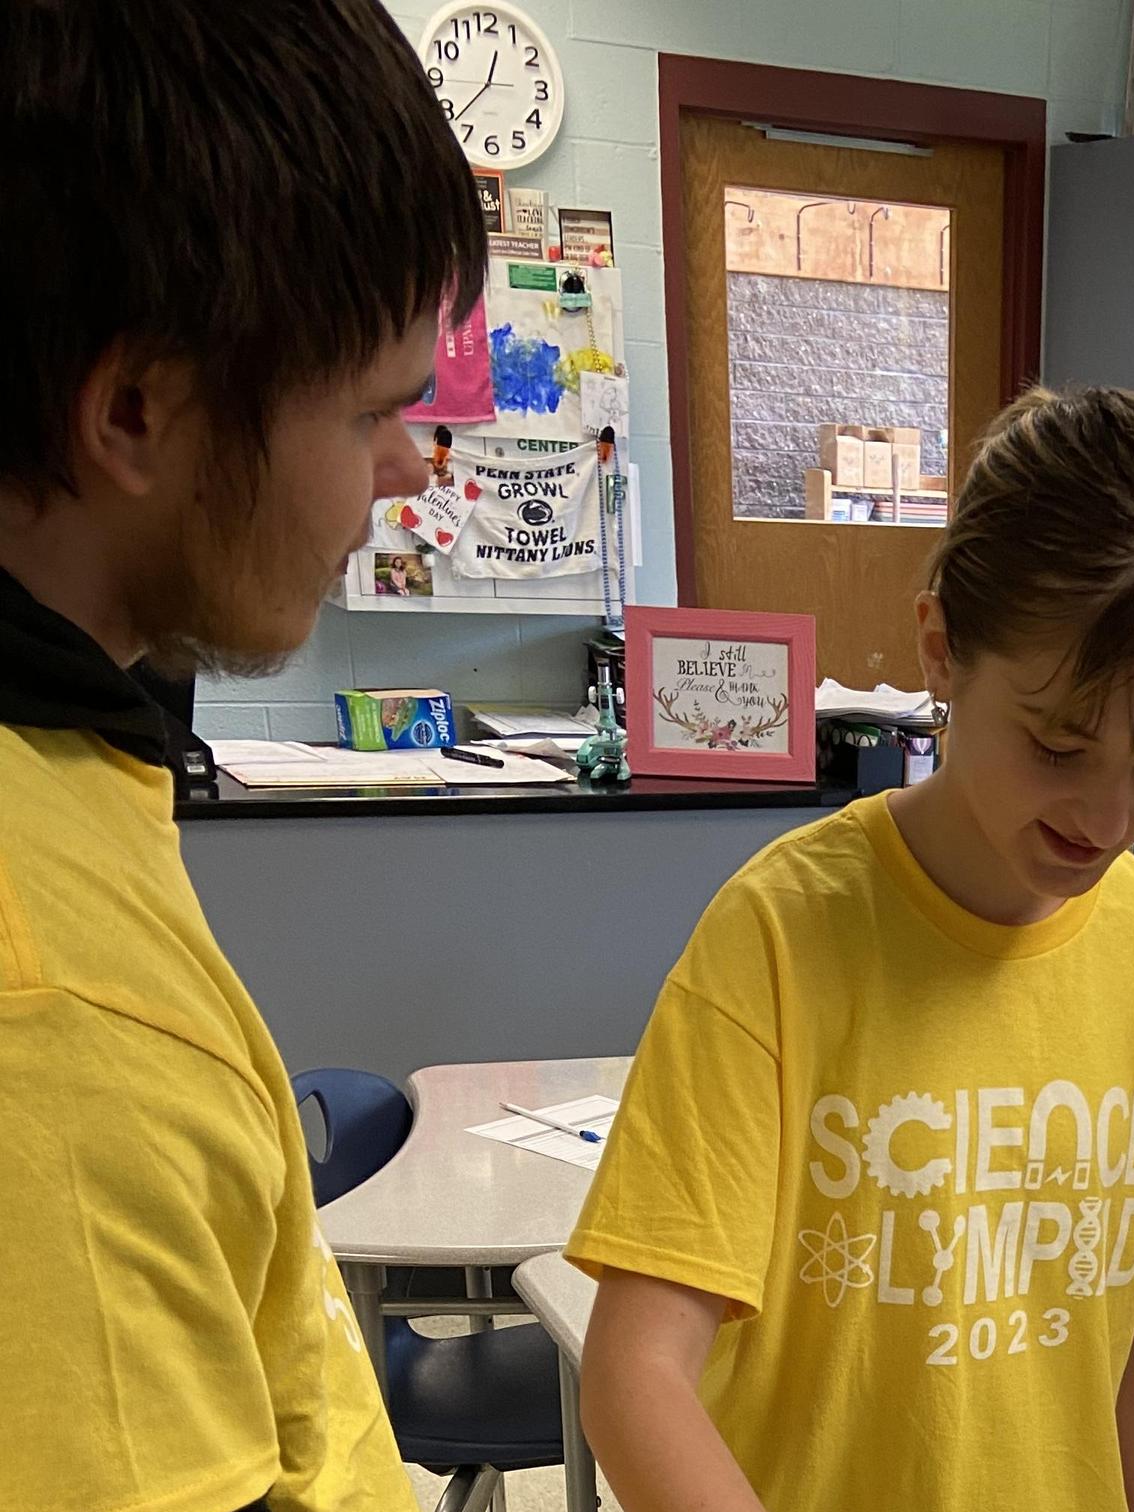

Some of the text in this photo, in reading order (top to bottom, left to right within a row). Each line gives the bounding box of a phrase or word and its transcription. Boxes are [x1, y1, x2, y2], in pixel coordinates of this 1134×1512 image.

[451, 18, 470, 40] 11
[473, 12, 498, 35] 12
[508, 24, 516, 45] 1
[434, 40, 459, 60] 10
[525, 46, 539, 67] 2
[428, 67, 443, 88] 9
[535, 80, 548, 101] 3
[440, 99, 454, 121] 8
[526, 108, 542, 129] 4
[461, 124, 473, 143] 7
[512, 131, 525, 149] 5
[484, 135, 499, 155] 6
[482, 199, 500, 211] ust
[511, 241, 539, 249] TEACHER
[475, 462, 576, 480] PENN STATE
[497, 481, 569, 500] GROWL
[429, 508, 444, 521] DAY
[504, 526, 567, 547] TOWEL
[476, 544, 550, 562] NITTANY
[719, 645, 747, 662] still
[677, 659, 737, 677] BELIEVE
[674, 678, 716, 692] Please
[429, 698, 451, 744] Ziploc
[925, 1307, 1071, 1366] 2023
